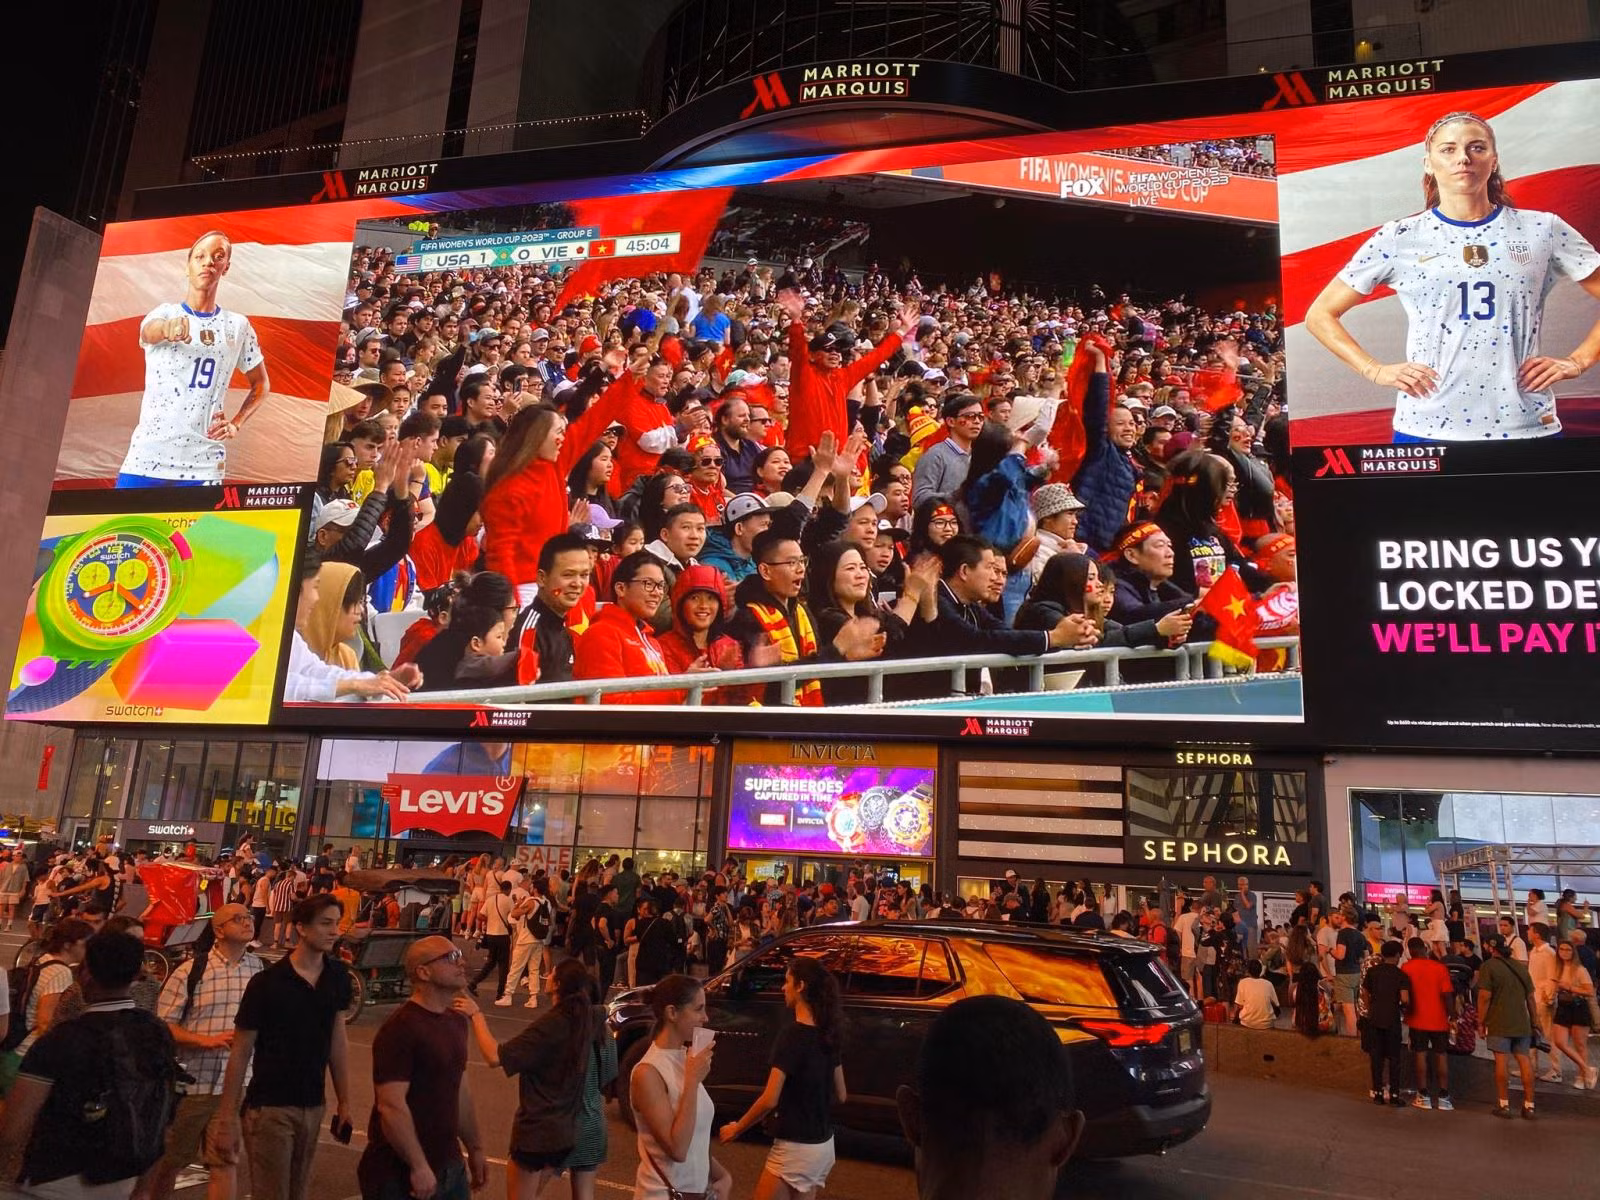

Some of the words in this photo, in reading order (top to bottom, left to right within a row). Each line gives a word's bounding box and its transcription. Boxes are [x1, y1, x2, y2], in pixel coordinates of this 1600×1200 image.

[804, 63, 920, 81] MARRIOTT
[1328, 59, 1445, 82] MARRIOTT
[803, 81, 905, 100] MARQUIS
[1329, 77, 1432, 99] MARQUIS
[359, 163, 438, 181] MARRIOTT
[1020, 156, 1052, 183] FIFA
[1130, 173, 1157, 183] FIFA
[1156, 166, 1220, 182] WOMEN'S
[356, 179, 426, 195] MARQUIS
[1060, 178, 1105, 199] FOX
[1117, 180, 1163, 193] WORLD
[1164, 178, 1191, 190] CUP
[1192, 175, 1229, 188] 2023
[1129, 196, 1159, 208] LIVE
[420, 243, 438, 251] FIFA
[438, 240, 473, 249] WOMEN'S
[475, 238, 503, 247] WORLD
[503, 236, 520, 245] CUP
[557, 231, 585, 240] GROUP
[586, 230, 593, 238] E
[625, 237, 671, 252] 45:04
[436, 254, 470, 267] USA
[480, 252, 487, 265] 1
[541, 246, 568, 259] VIE
[1508, 245, 1529, 254] USA
[1457, 281, 1496, 321] 13
[189, 357, 216, 389] 19
[1362, 446, 1447, 459] MARRIOTT
[1363, 459, 1438, 471] MARQUIS
[247, 486, 303, 496] MARRIOTT
[246, 496, 294, 506] MARQUIS
[1378, 538, 1501, 569] BRING
[1510, 537, 1564, 568] US
[1569, 537, 1600, 567] Y
[1378, 580, 1535, 611] LOCKED
[1544, 579, 1600, 610] DE
[1371, 622, 1492, 653] WE'LL
[1499, 622, 1575, 653] PAY
[105, 704, 155, 717] swatch
[986, 719, 1034, 727] MARRIOTT
[986, 727, 1029, 735] MARQUIS
[790, 743, 876, 761] INVICTA
[1176, 752, 1253, 765] SEPHORA
[743, 778, 845, 794] SUPERHEROES
[754, 791, 800, 802] CAPTURED
[800, 792, 810, 802] IN
[810, 793, 833, 803] TIME
[147, 824, 188, 835] swatch
[796, 817, 825, 826] INVICTA
[518, 847, 570, 864] SALE
[1143, 840, 1292, 866] SEPHORA
